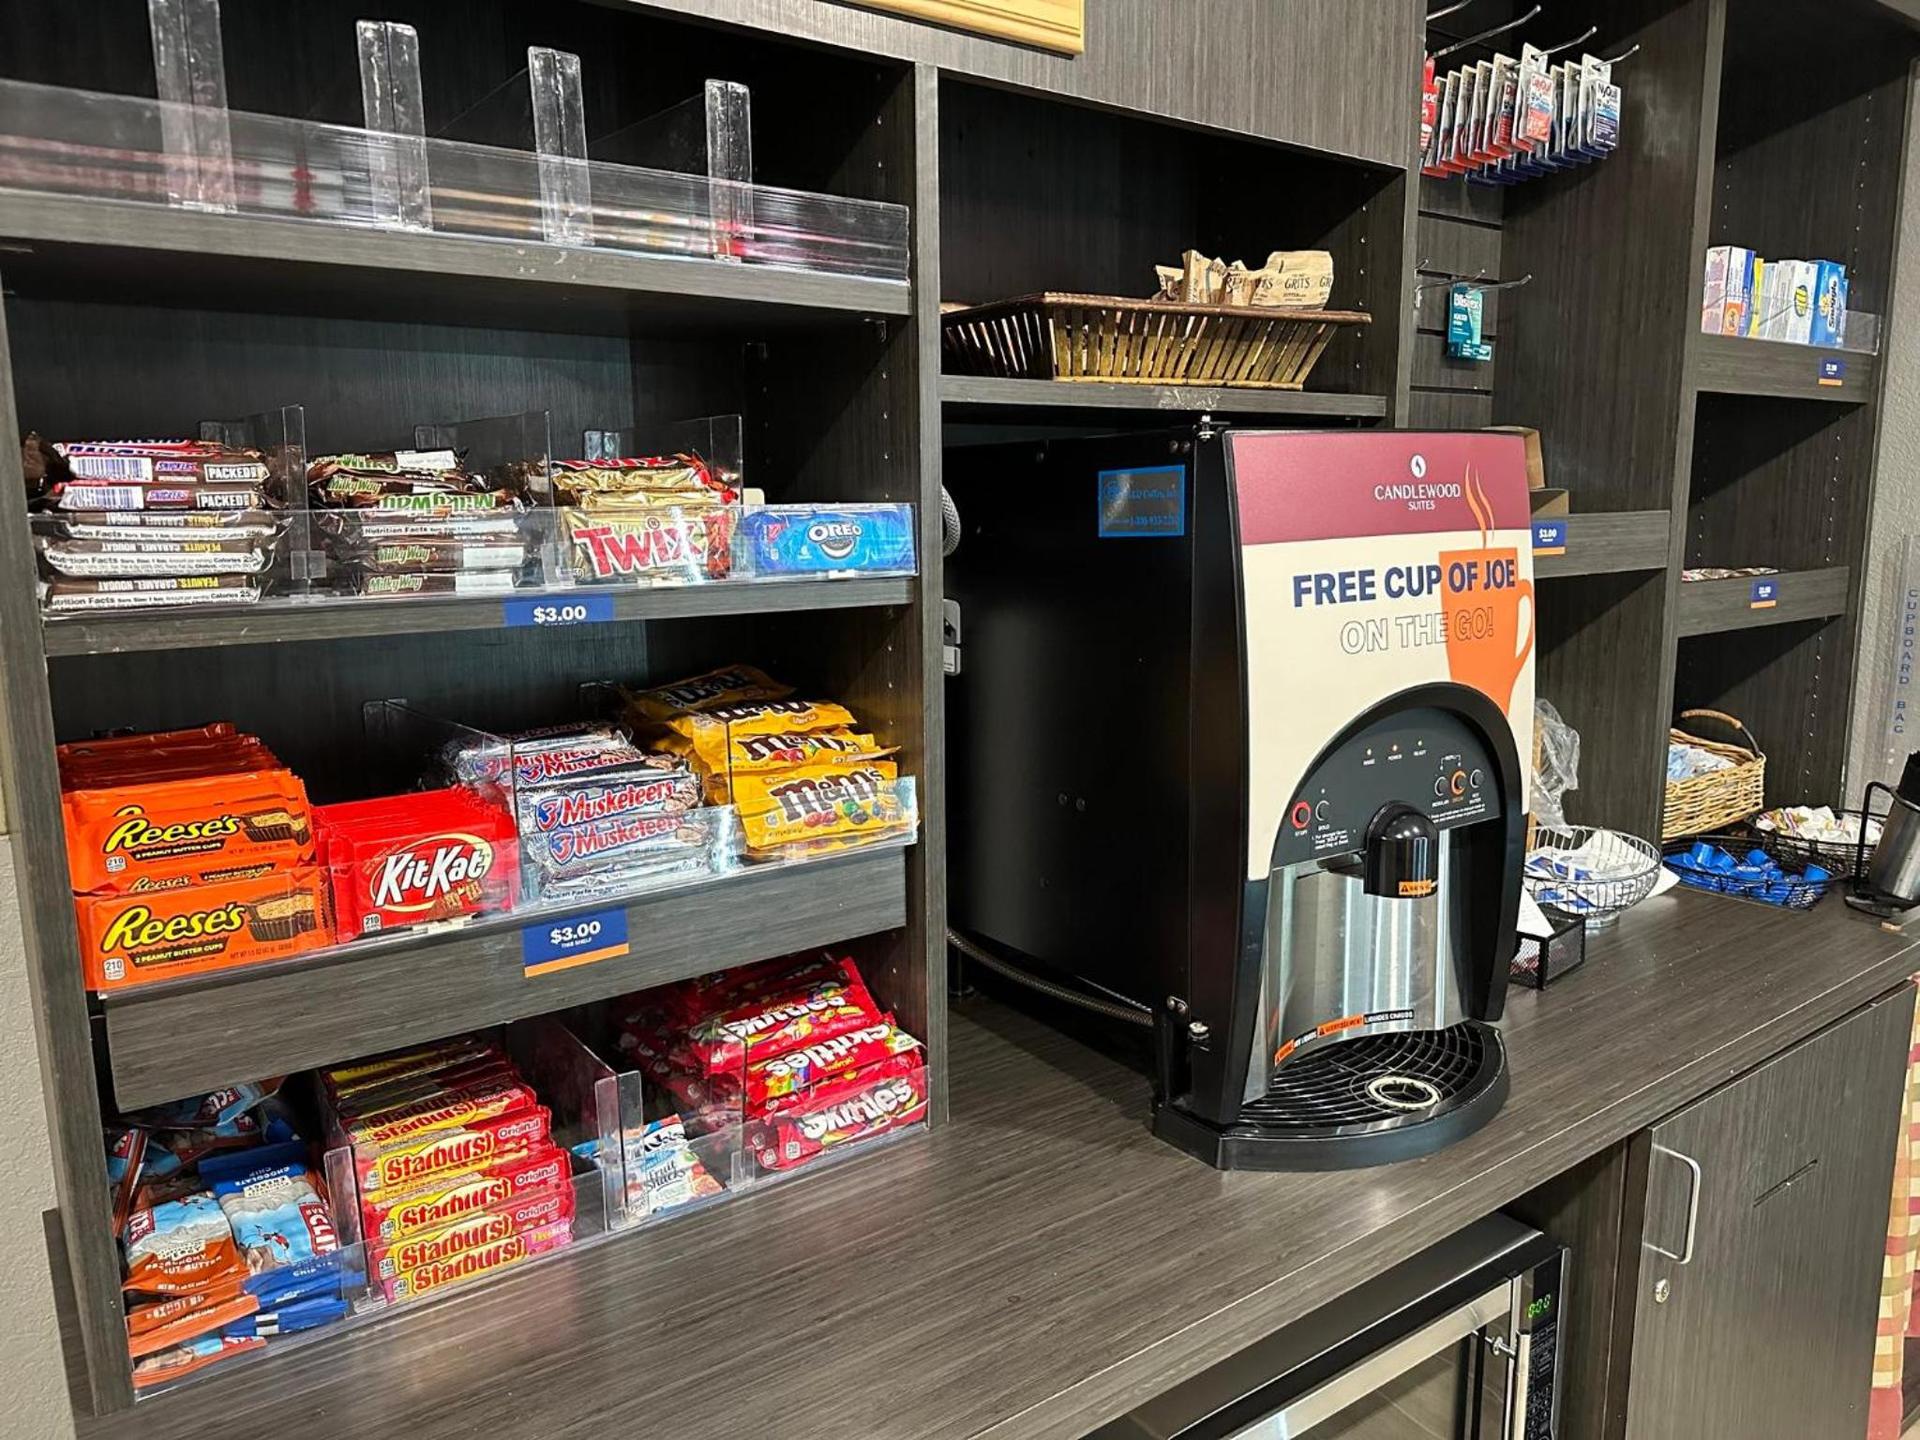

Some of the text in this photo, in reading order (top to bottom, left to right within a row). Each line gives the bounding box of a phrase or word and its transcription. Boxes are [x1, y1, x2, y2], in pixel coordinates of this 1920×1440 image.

[1285, 277, 1311, 289] GRITS
[208, 465, 248, 479] PACKED
[200, 495, 246, 507] PACKED
[1374, 483, 1462, 501] CANDLEWOOD
[1408, 500, 1436, 511] SUITES
[808, 523, 863, 542] OREO
[1293, 559, 1515, 608] FREE CUP OF JOE
[51, 597, 87, 606] utrition
[533, 605, 587, 624] $3.00
[1340, 606, 1494, 655] ON THE GO!
[543, 782, 675, 828] 3 Musketeers
[104, 815, 241, 853] Reese's
[575, 816, 684, 858] Musketeers
[142, 850, 172, 859] PEANUT
[202, 842, 222, 851] CUPS
[108, 857, 124, 867] 210
[130, 875, 190, 893] Reese's
[103, 905, 246, 953] Reese's
[551, 921, 602, 945] $3.00
[142, 952, 172, 963] PEANUT
[173, 947, 202, 958] BUTTER
[204, 942, 224, 952] CUPS
[105, 960, 123, 971] 210
[385, 1121, 540, 1182] Starburst Original
[402, 1164, 558, 1228] Starburst Original
[400, 1216, 509, 1271] Starburst
[516, 1201, 558, 1220] Original
[413, 1237, 524, 1291] Starburst
